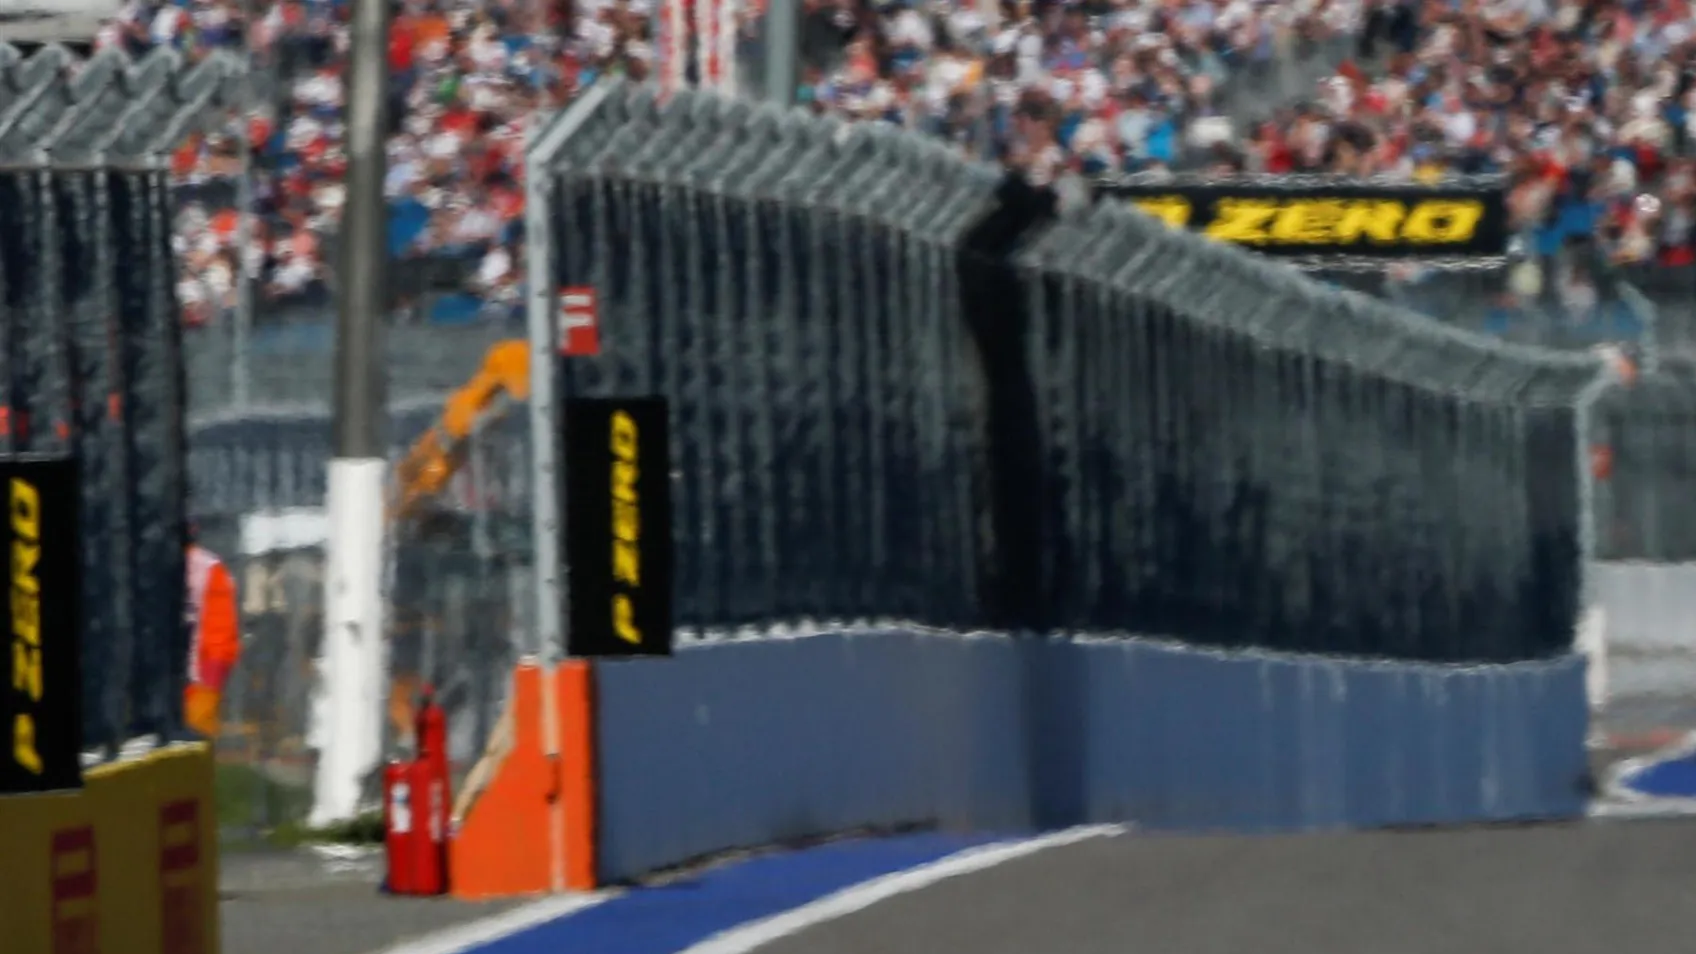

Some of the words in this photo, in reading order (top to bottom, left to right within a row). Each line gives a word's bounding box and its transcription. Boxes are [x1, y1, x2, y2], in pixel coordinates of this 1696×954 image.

[1205, 195, 1484, 246] ZERO
[610, 409, 643, 586] ZERO
[9, 477, 44, 702] ZERO
[610, 594, 643, 645] P
[11, 713, 45, 775] P
